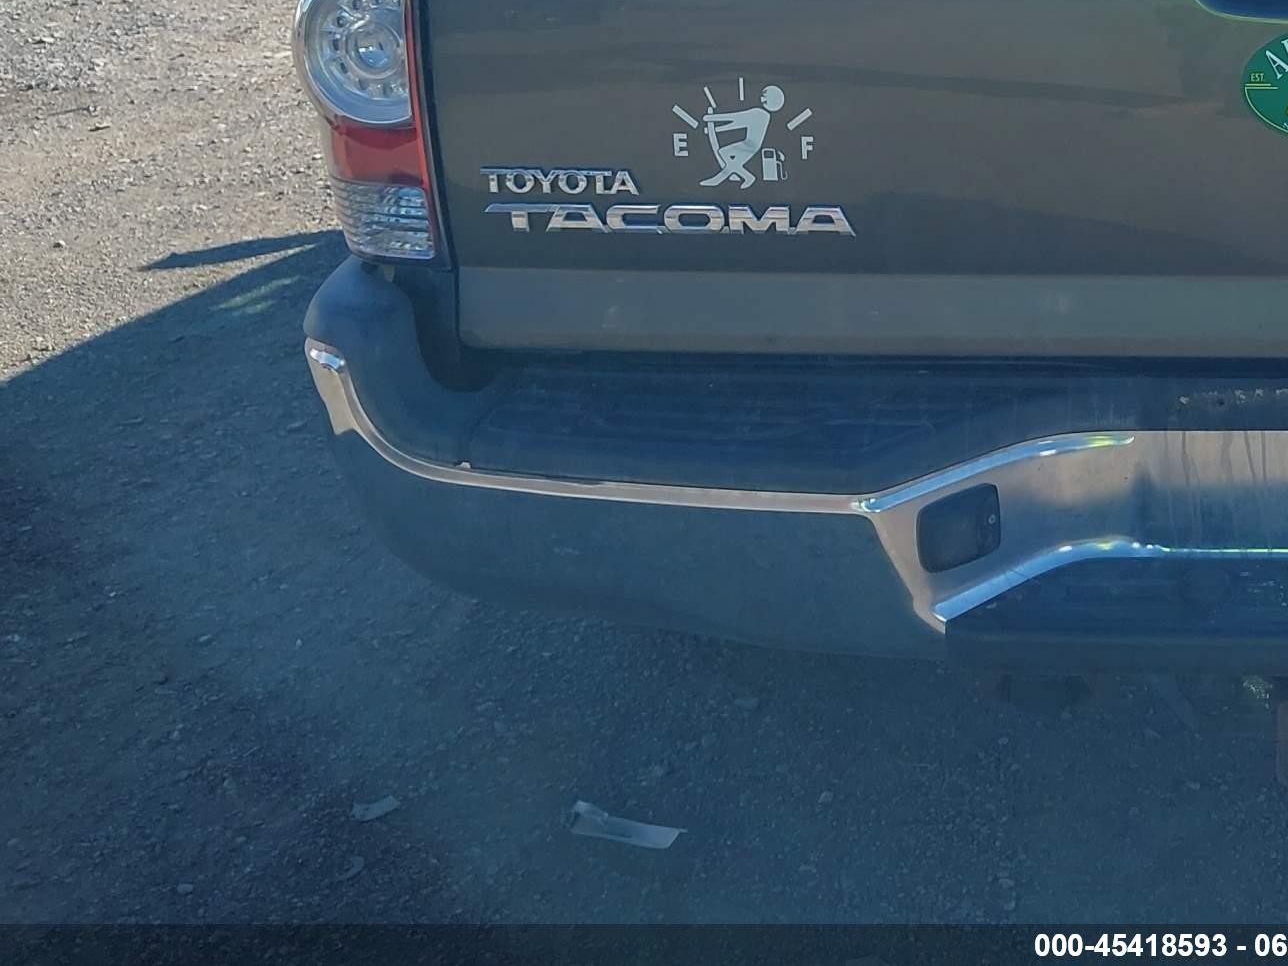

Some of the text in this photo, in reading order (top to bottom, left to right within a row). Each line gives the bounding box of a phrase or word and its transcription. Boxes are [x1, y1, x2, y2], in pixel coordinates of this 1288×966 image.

[673, 133, 689, 157] E
[801, 136, 813, 160] F
[480, 167, 640, 196] TOYOTA
[485, 203, 856, 237] TACOMA
